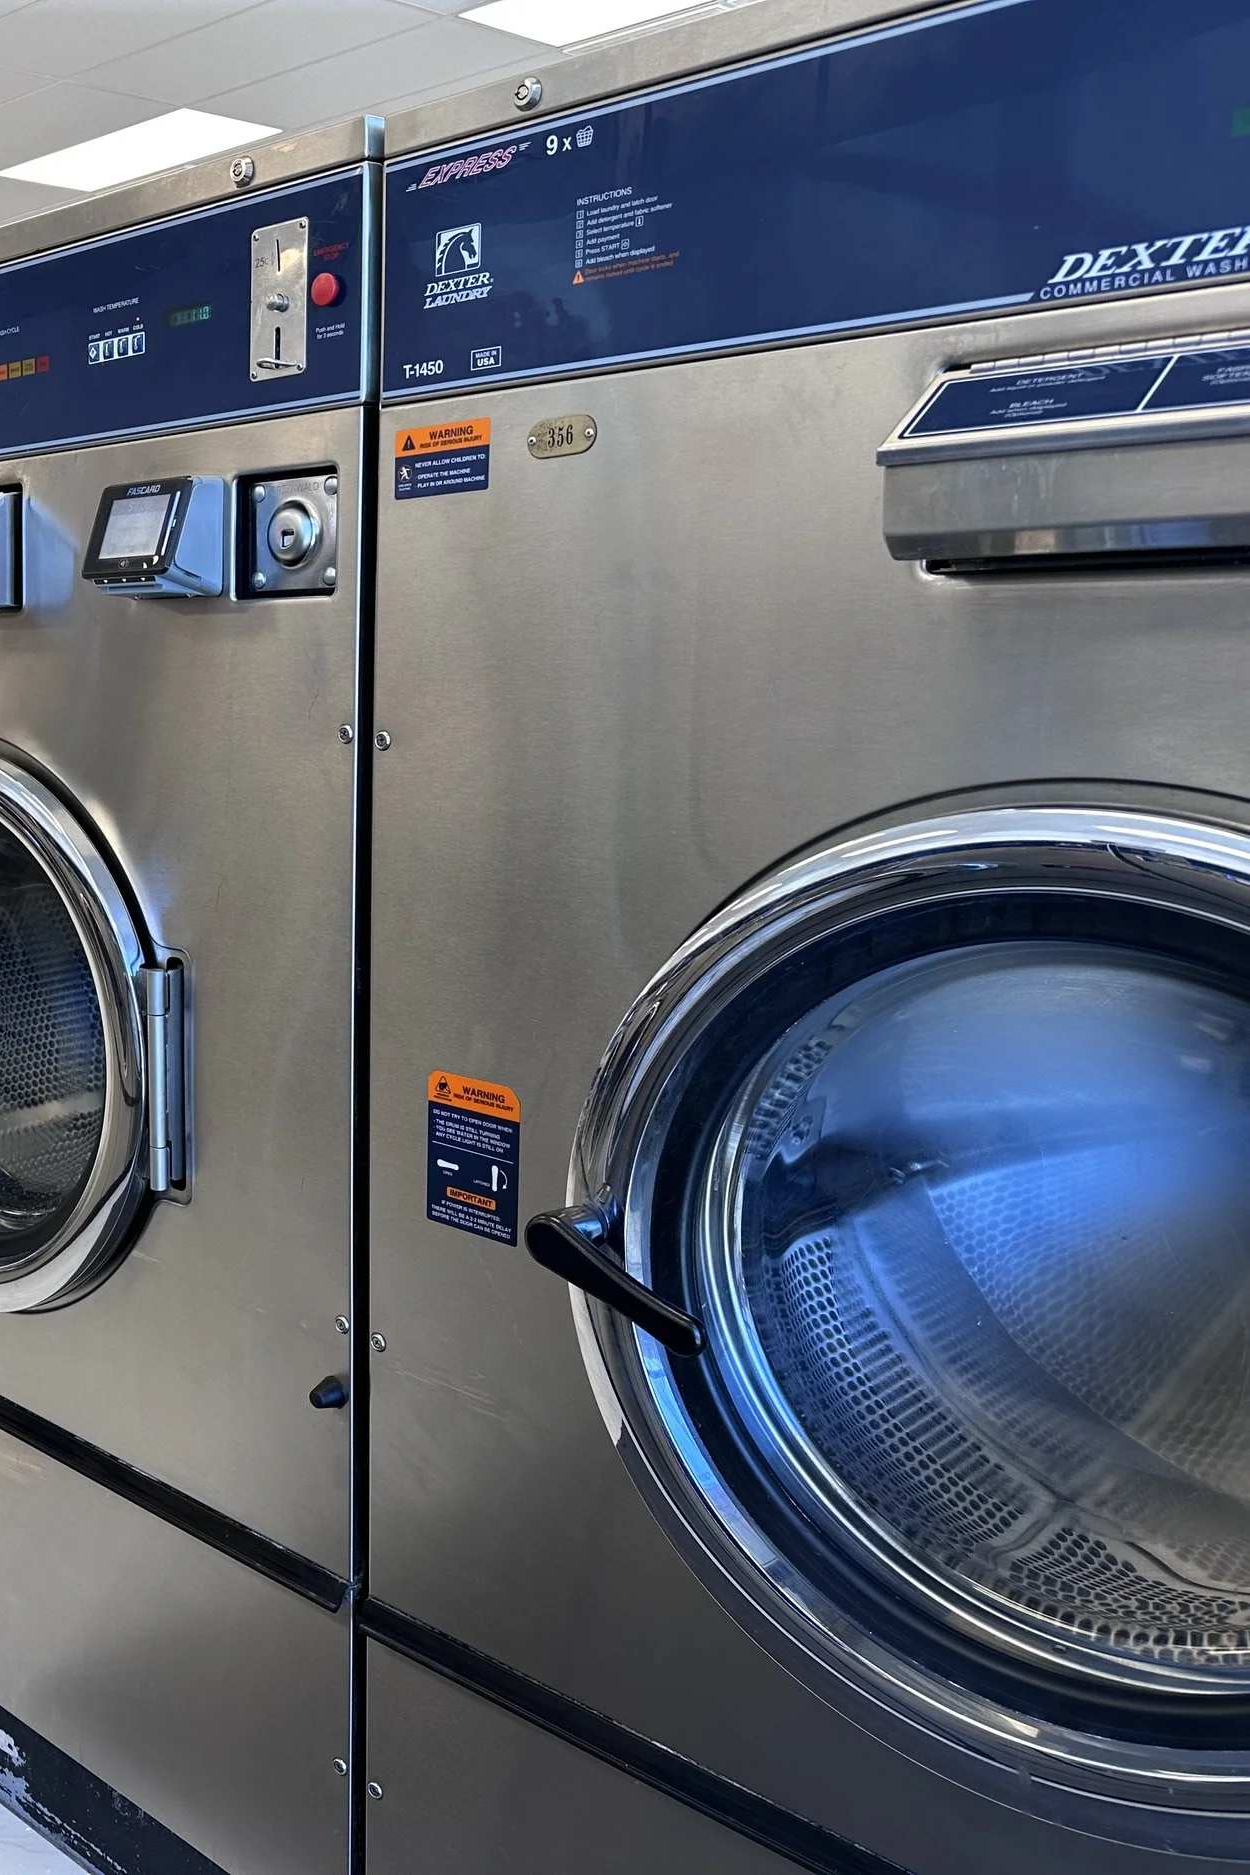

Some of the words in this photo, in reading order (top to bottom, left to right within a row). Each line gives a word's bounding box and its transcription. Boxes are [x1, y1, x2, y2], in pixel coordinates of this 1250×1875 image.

[546, 135, 558, 155] 9
[418, 146, 517, 188] EXPRESS
[577, 187, 632, 206] INSTRUCTIONS
[598, 213, 622, 222] detergent
[635, 207, 649, 215] fabric
[651, 203, 672, 211] softener
[601, 205, 619, 213] laundry
[586, 227, 602, 235] Select
[603, 221, 634, 231] temperature
[598, 234, 620, 243] payment
[597, 254, 614, 262] bleach
[630, 245, 655, 256] displayed
[601, 243, 620, 251] START
[424, 272, 490, 296] DEXTER
[1040, 269, 1176, 299] COMMERCIAL
[107, 297, 139, 310] TEMPERATURE
[423, 286, 492, 309] LAUNDRY
[7, 326, 20, 334] CYCLE
[477, 356, 494, 367] USA
[403, 360, 444, 378] T-1450
[1016, 373, 1083, 385] DETERGENT
[1010, 399, 1054, 408] BLEACH
[429, 425, 473, 440] WARNING
[548, 425, 573, 448] 356
[441, 437, 462, 446] SERIOUS
[415, 460, 431, 468] NEVER
[433, 458, 450, 466] ALLOW
[451, 454, 476, 464] CHILDREN
[418, 472, 439, 480] OPERATE
[127, 485, 161, 496] FASCARD
[462, 1086, 506, 1103] WARNING
[474, 1098, 494, 1108] SERIOUS
[496, 1103, 514, 1112] INJURY
[446, 1121, 459, 1129] DRUM
[466, 1126, 478, 1134] STILL
[479, 1130, 500, 1139] TURNING
[483, 1121, 496, 1129] DOOR
[446, 1134, 461, 1142] CYCLE
[462, 1138, 476, 1146] LIGHT
[456, 1130, 473, 1138] WATER
[490, 1139, 510, 1148] WINDOW
[450, 1189, 492, 1207] IMPORTANT
[446, 1202, 462, 1210] POWER
[432, 1204, 446, 1213] THERE
[478, 1218, 494, 1228] MINUTE
[496, 1224, 511, 1233] DELAY
[432, 1211, 449, 1220] BEFORE
[460, 1219, 473, 1227] DOOR
[491, 1229, 510, 1239] OPENED
